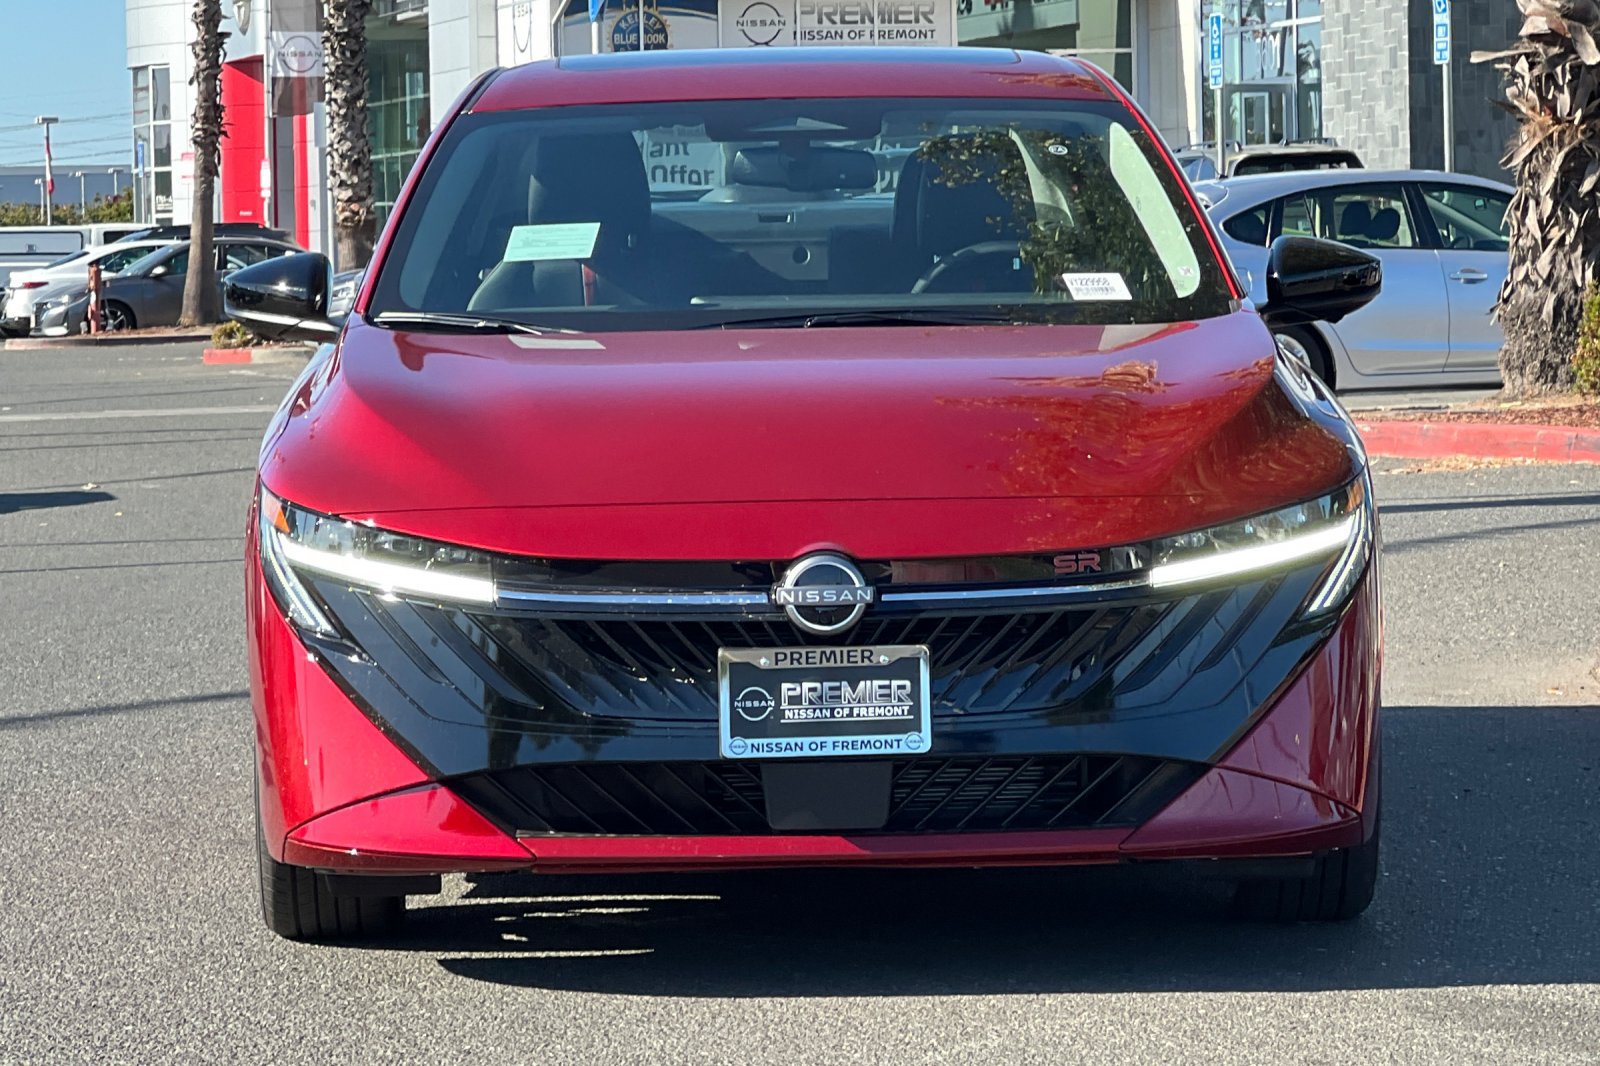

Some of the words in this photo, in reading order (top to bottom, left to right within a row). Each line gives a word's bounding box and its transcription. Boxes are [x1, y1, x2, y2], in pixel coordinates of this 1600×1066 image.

[793, 0, 935, 25] PREMIER
[736, 19, 786, 27] NISSAN
[613, 33, 638, 45] BLUE
[644, 33, 666, 44] OOK
[847, 29, 866, 40] OF
[1053, 553, 1101, 574] SR
[780, 589, 871, 603] NISSAN
[774, 649, 874, 666] PREMIER
[780, 679, 914, 706] PREMIER
[734, 700, 775, 708] NISSAN
[784, 708, 831, 719] NISSAN
[833, 707, 850, 718] OF
[853, 706, 910, 717] FREMONT
[750, 741, 804, 753] NISSAN
[808, 741, 828, 751] OF
[832, 738, 903, 750] FREMONT
